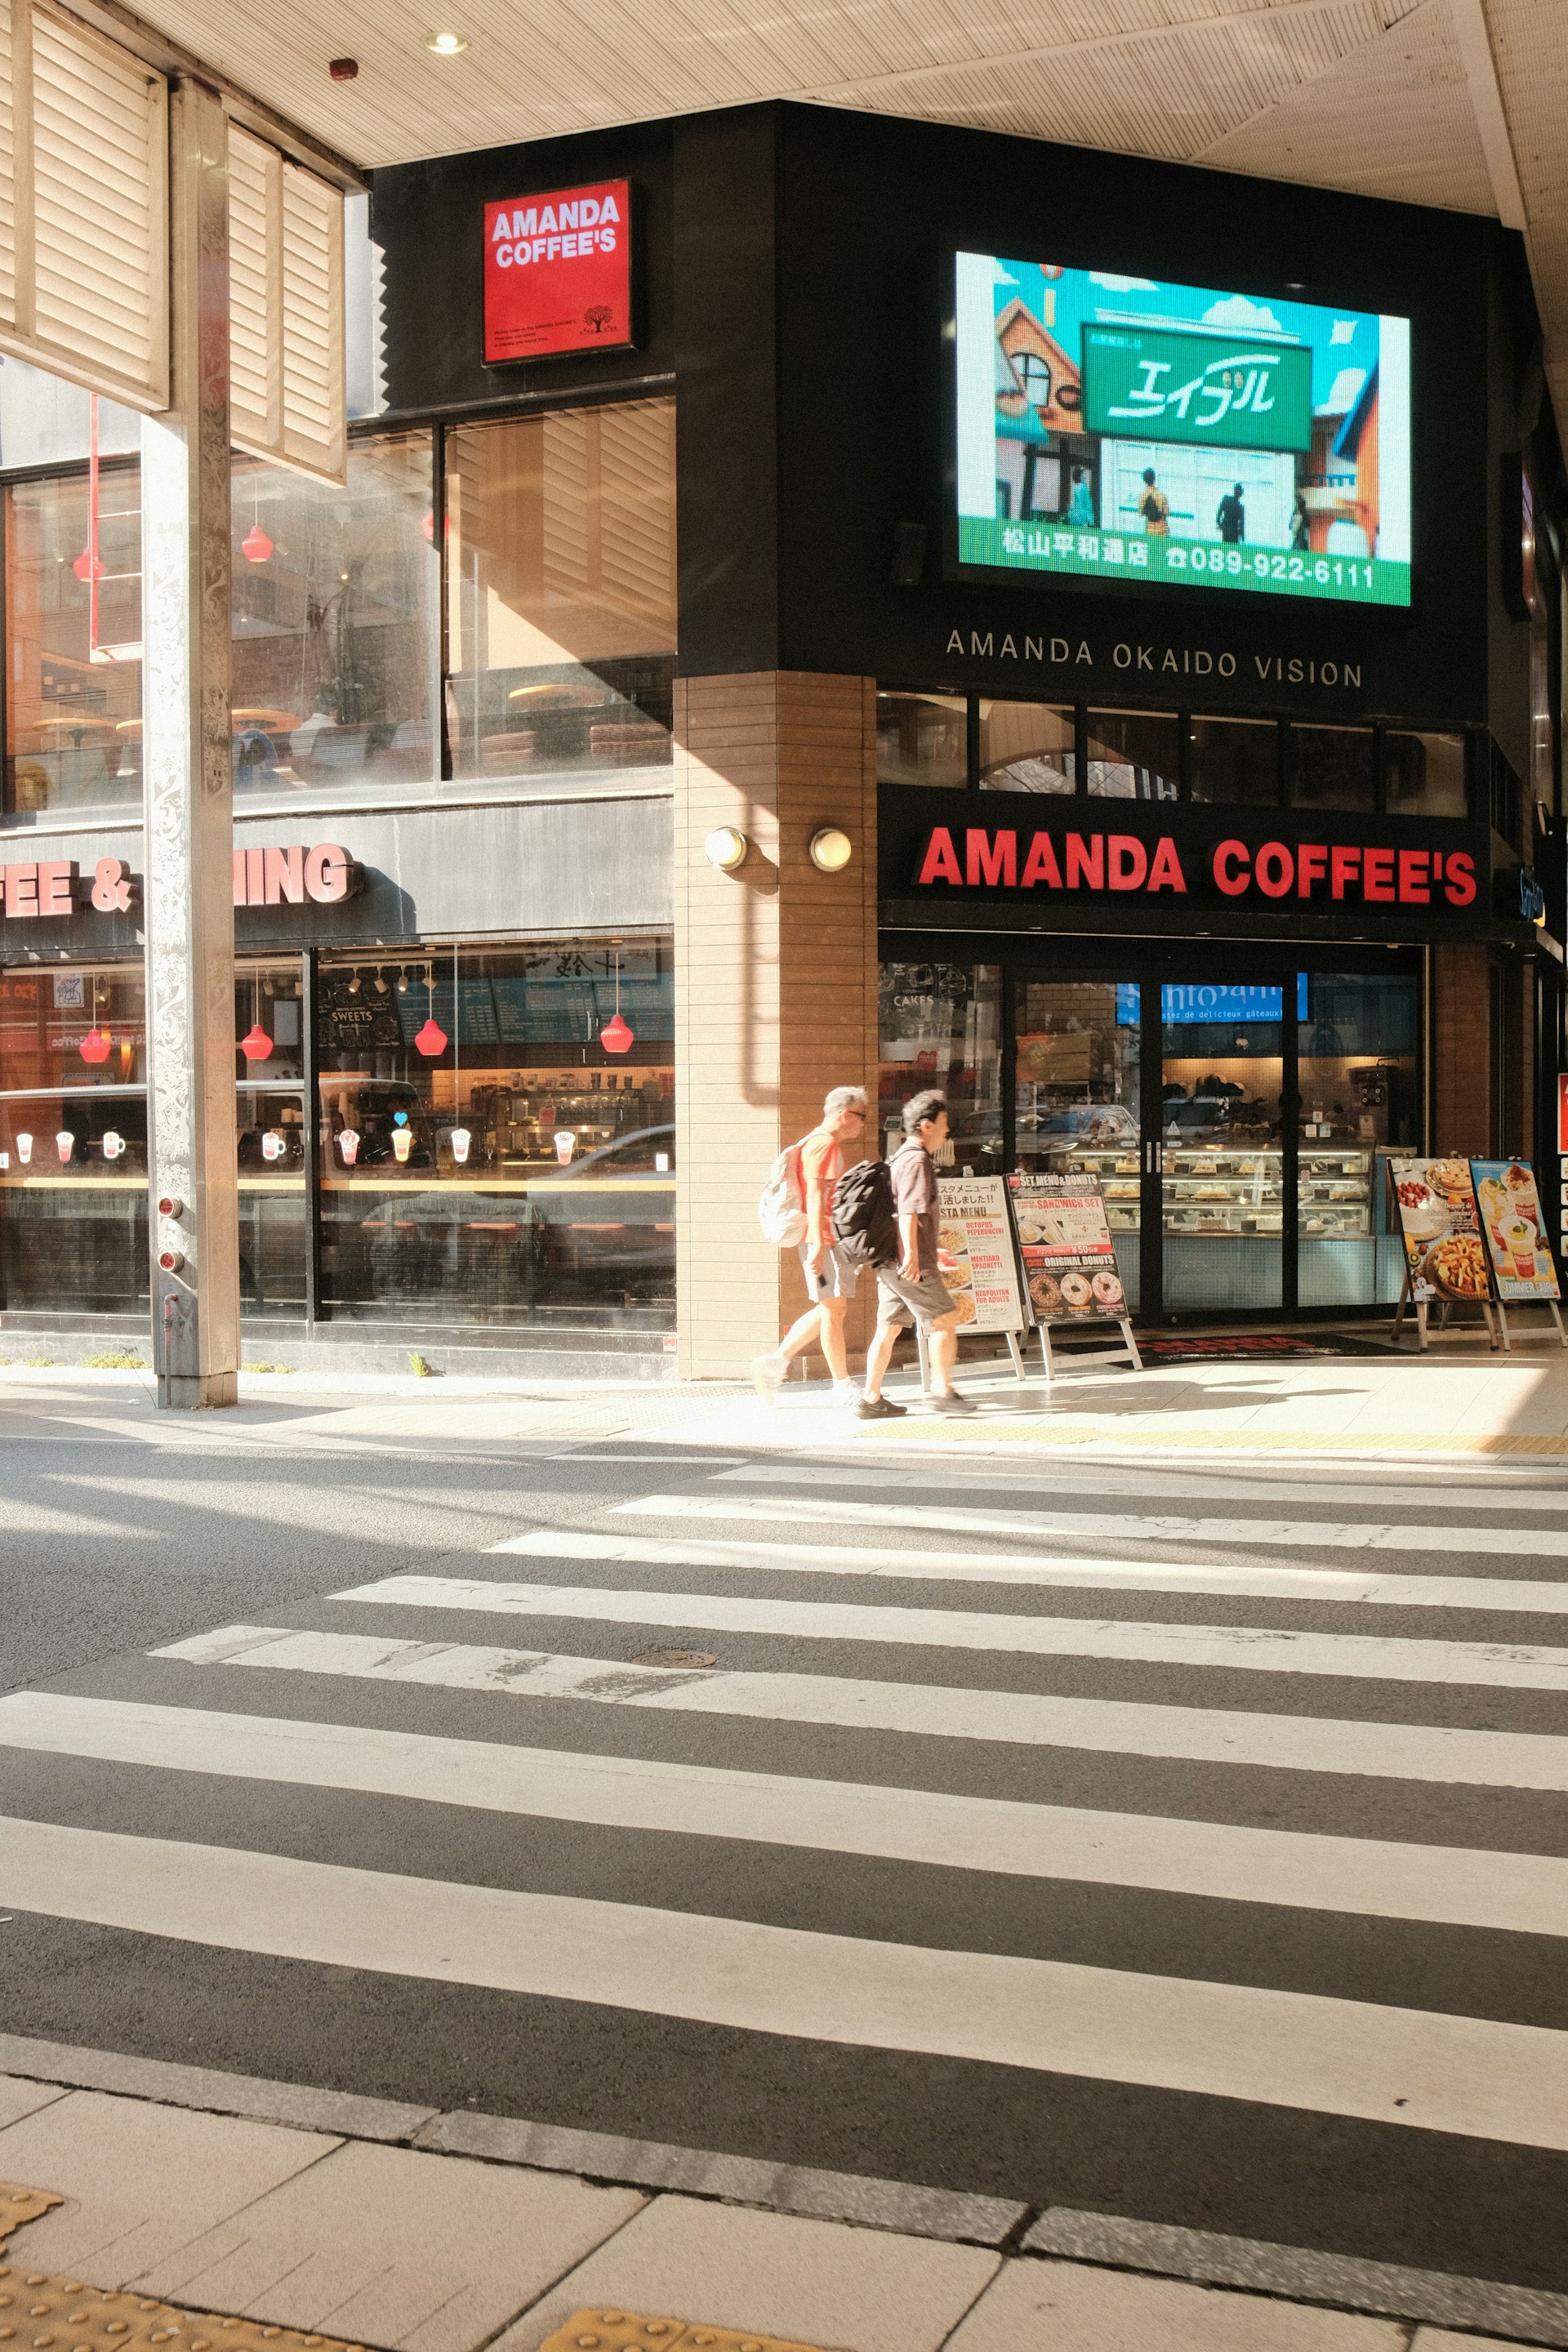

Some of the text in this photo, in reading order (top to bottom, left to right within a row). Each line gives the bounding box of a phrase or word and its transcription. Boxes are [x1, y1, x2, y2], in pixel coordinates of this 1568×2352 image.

[492, 195, 621, 242] AMANDA
[496, 228, 617, 269] COFFEE'S
[1107, 354, 1281, 427] エイブル
[1004, 528, 1374, 589] 松山平和通店 089-922-6111
[946, 629, 1363, 688] AMANDA OKAIDO VISION
[919, 826, 1187, 894] AMANDA
[1212, 839, 1477, 907] COFFEE'S
[91, 857, 133, 912] &
[893, 995, 933, 1007] CAKES
[332, 1011, 373, 1022] SWEETS
[1020, 1176, 1035, 1187] SET
[940, 1183, 998, 1194] スタメニューが
[1037, 1198, 1099, 1209] SANDWICH SET
[940, 1206, 987, 1218] STA MENU
[966, 1221, 993, 1229] OCTOPUS
[967, 1227, 1004, 1236] PEPERONCINI
[971, 1262, 1003, 1270] SPAGHETTI
[1045, 1255, 1115, 1267] ORIGINAL DONUTS
[975, 1289, 1009, 1297] NEAPOLITAN
[1500, 1281, 1552, 1294] SUMMER FAIR
